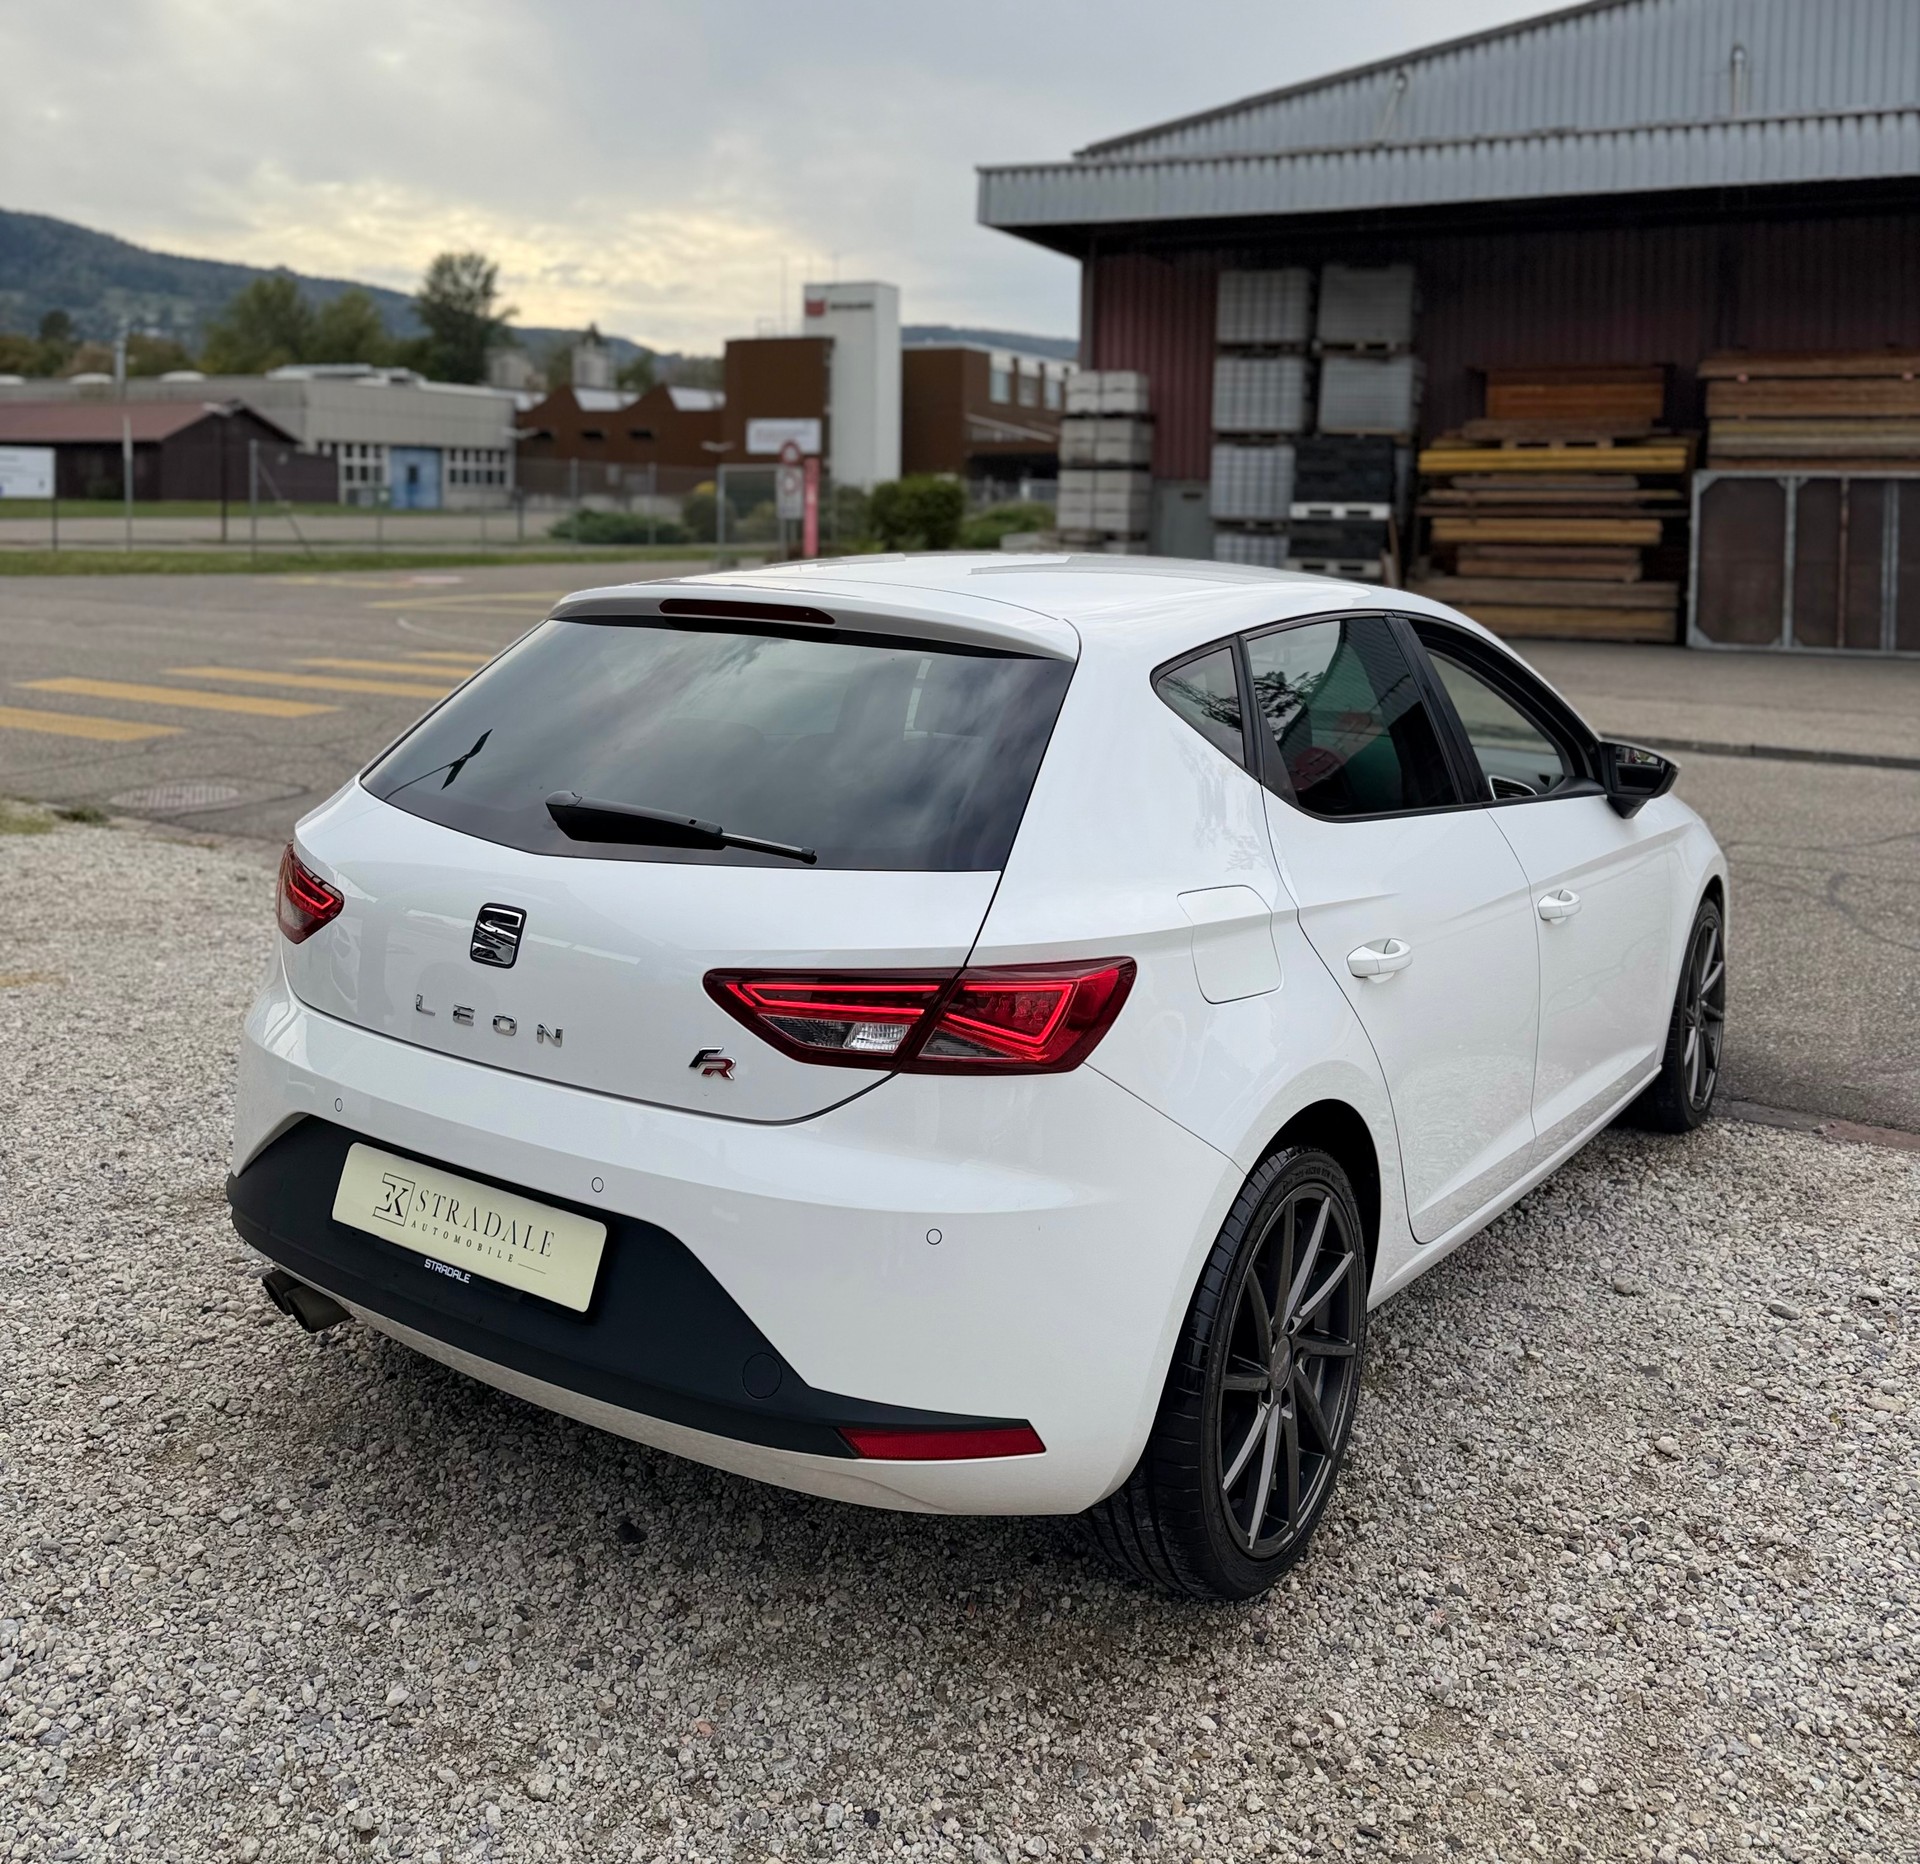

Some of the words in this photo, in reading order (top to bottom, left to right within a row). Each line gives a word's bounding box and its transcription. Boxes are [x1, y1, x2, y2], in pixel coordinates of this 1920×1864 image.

[415, 994, 563, 1047] LEON
[689, 1047, 736, 1080] FR
[411, 1219, 514, 1264] AUTOMOBILE
[416, 1189, 554, 1257] STRADALE
[424, 1258, 471, 1284] STRADALE
